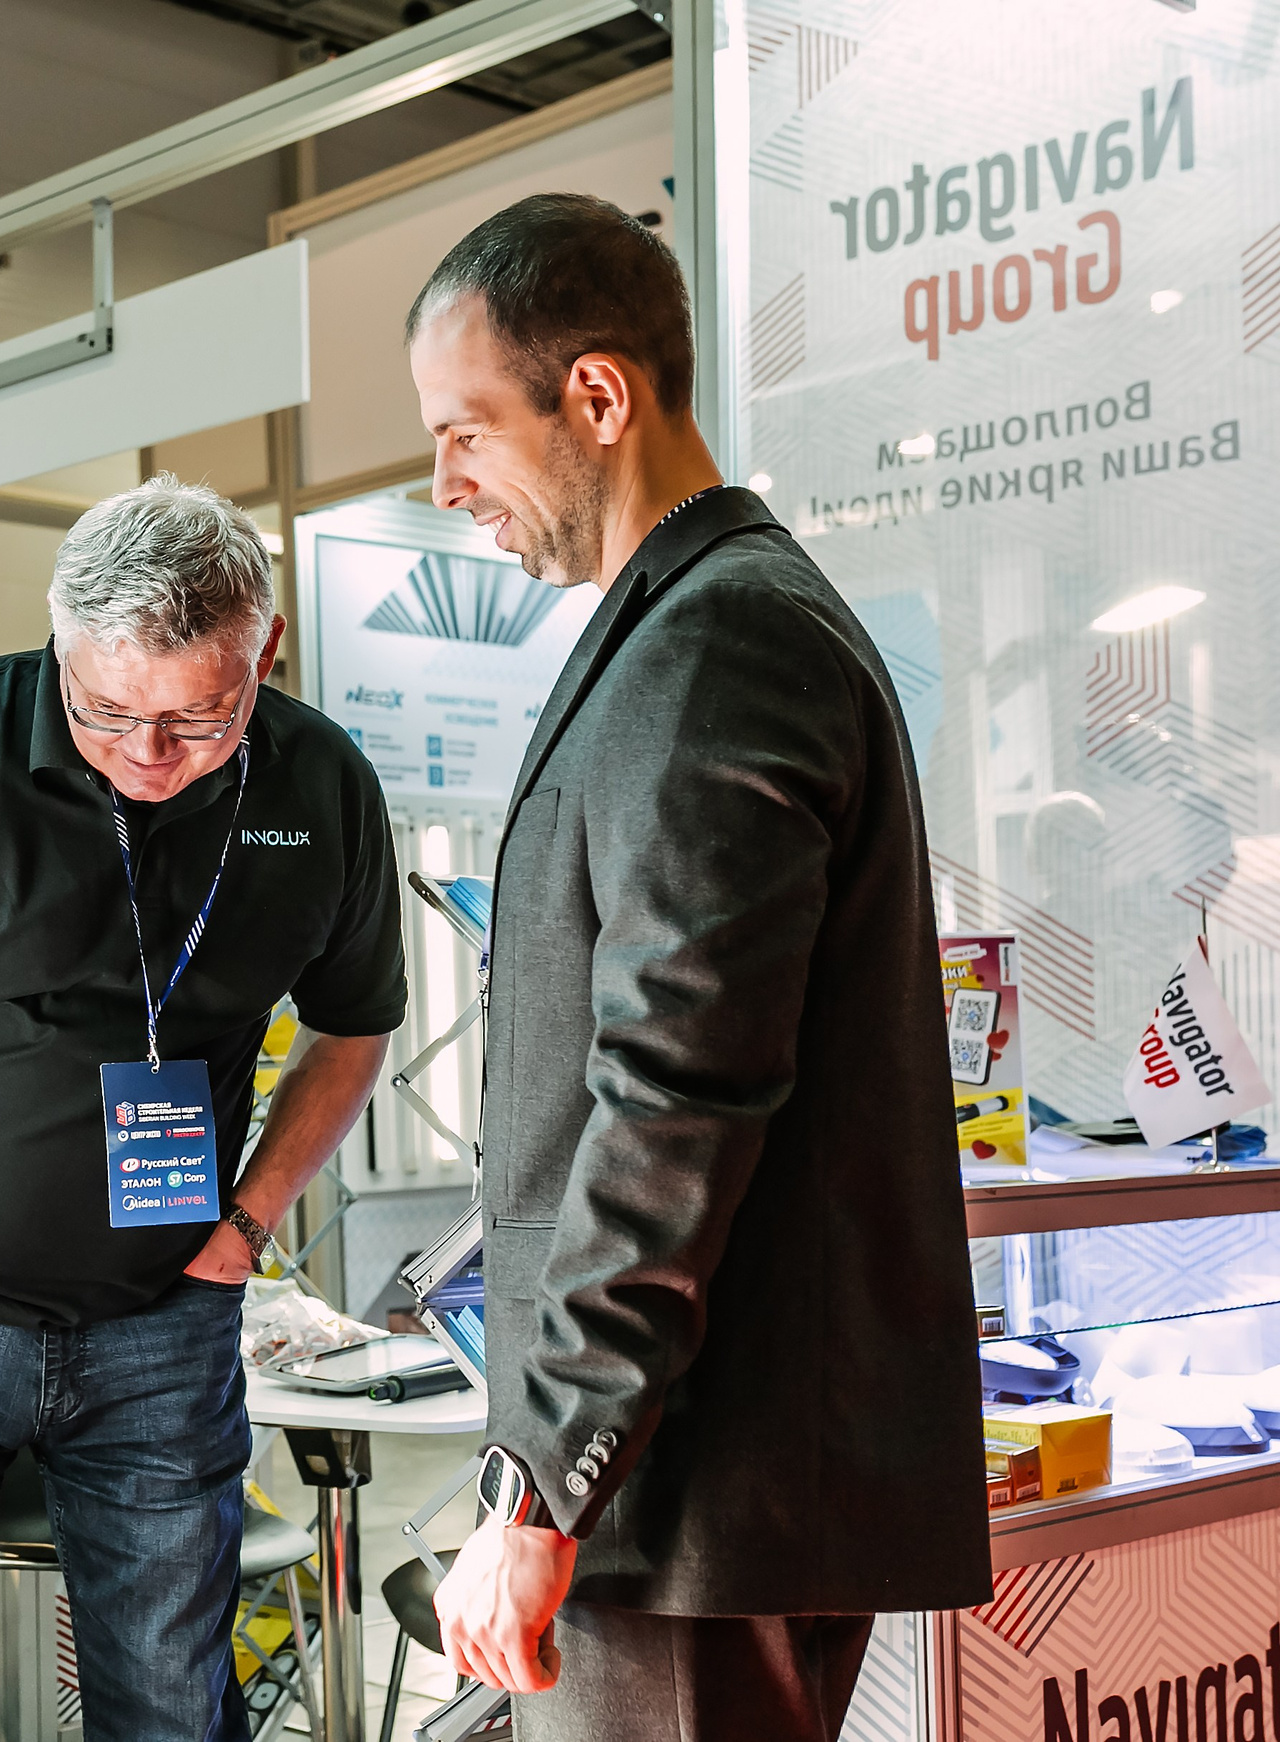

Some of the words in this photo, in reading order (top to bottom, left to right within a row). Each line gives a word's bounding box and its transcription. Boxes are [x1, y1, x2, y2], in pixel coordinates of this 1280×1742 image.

[1139, 1006, 1181, 1089] roup
[141, 1157, 180, 1171] Русский
[121, 1177, 162, 1189] ЭТАЛОН
[183, 1173, 207, 1184] Corp
[122, 1194, 161, 1212] Midea
